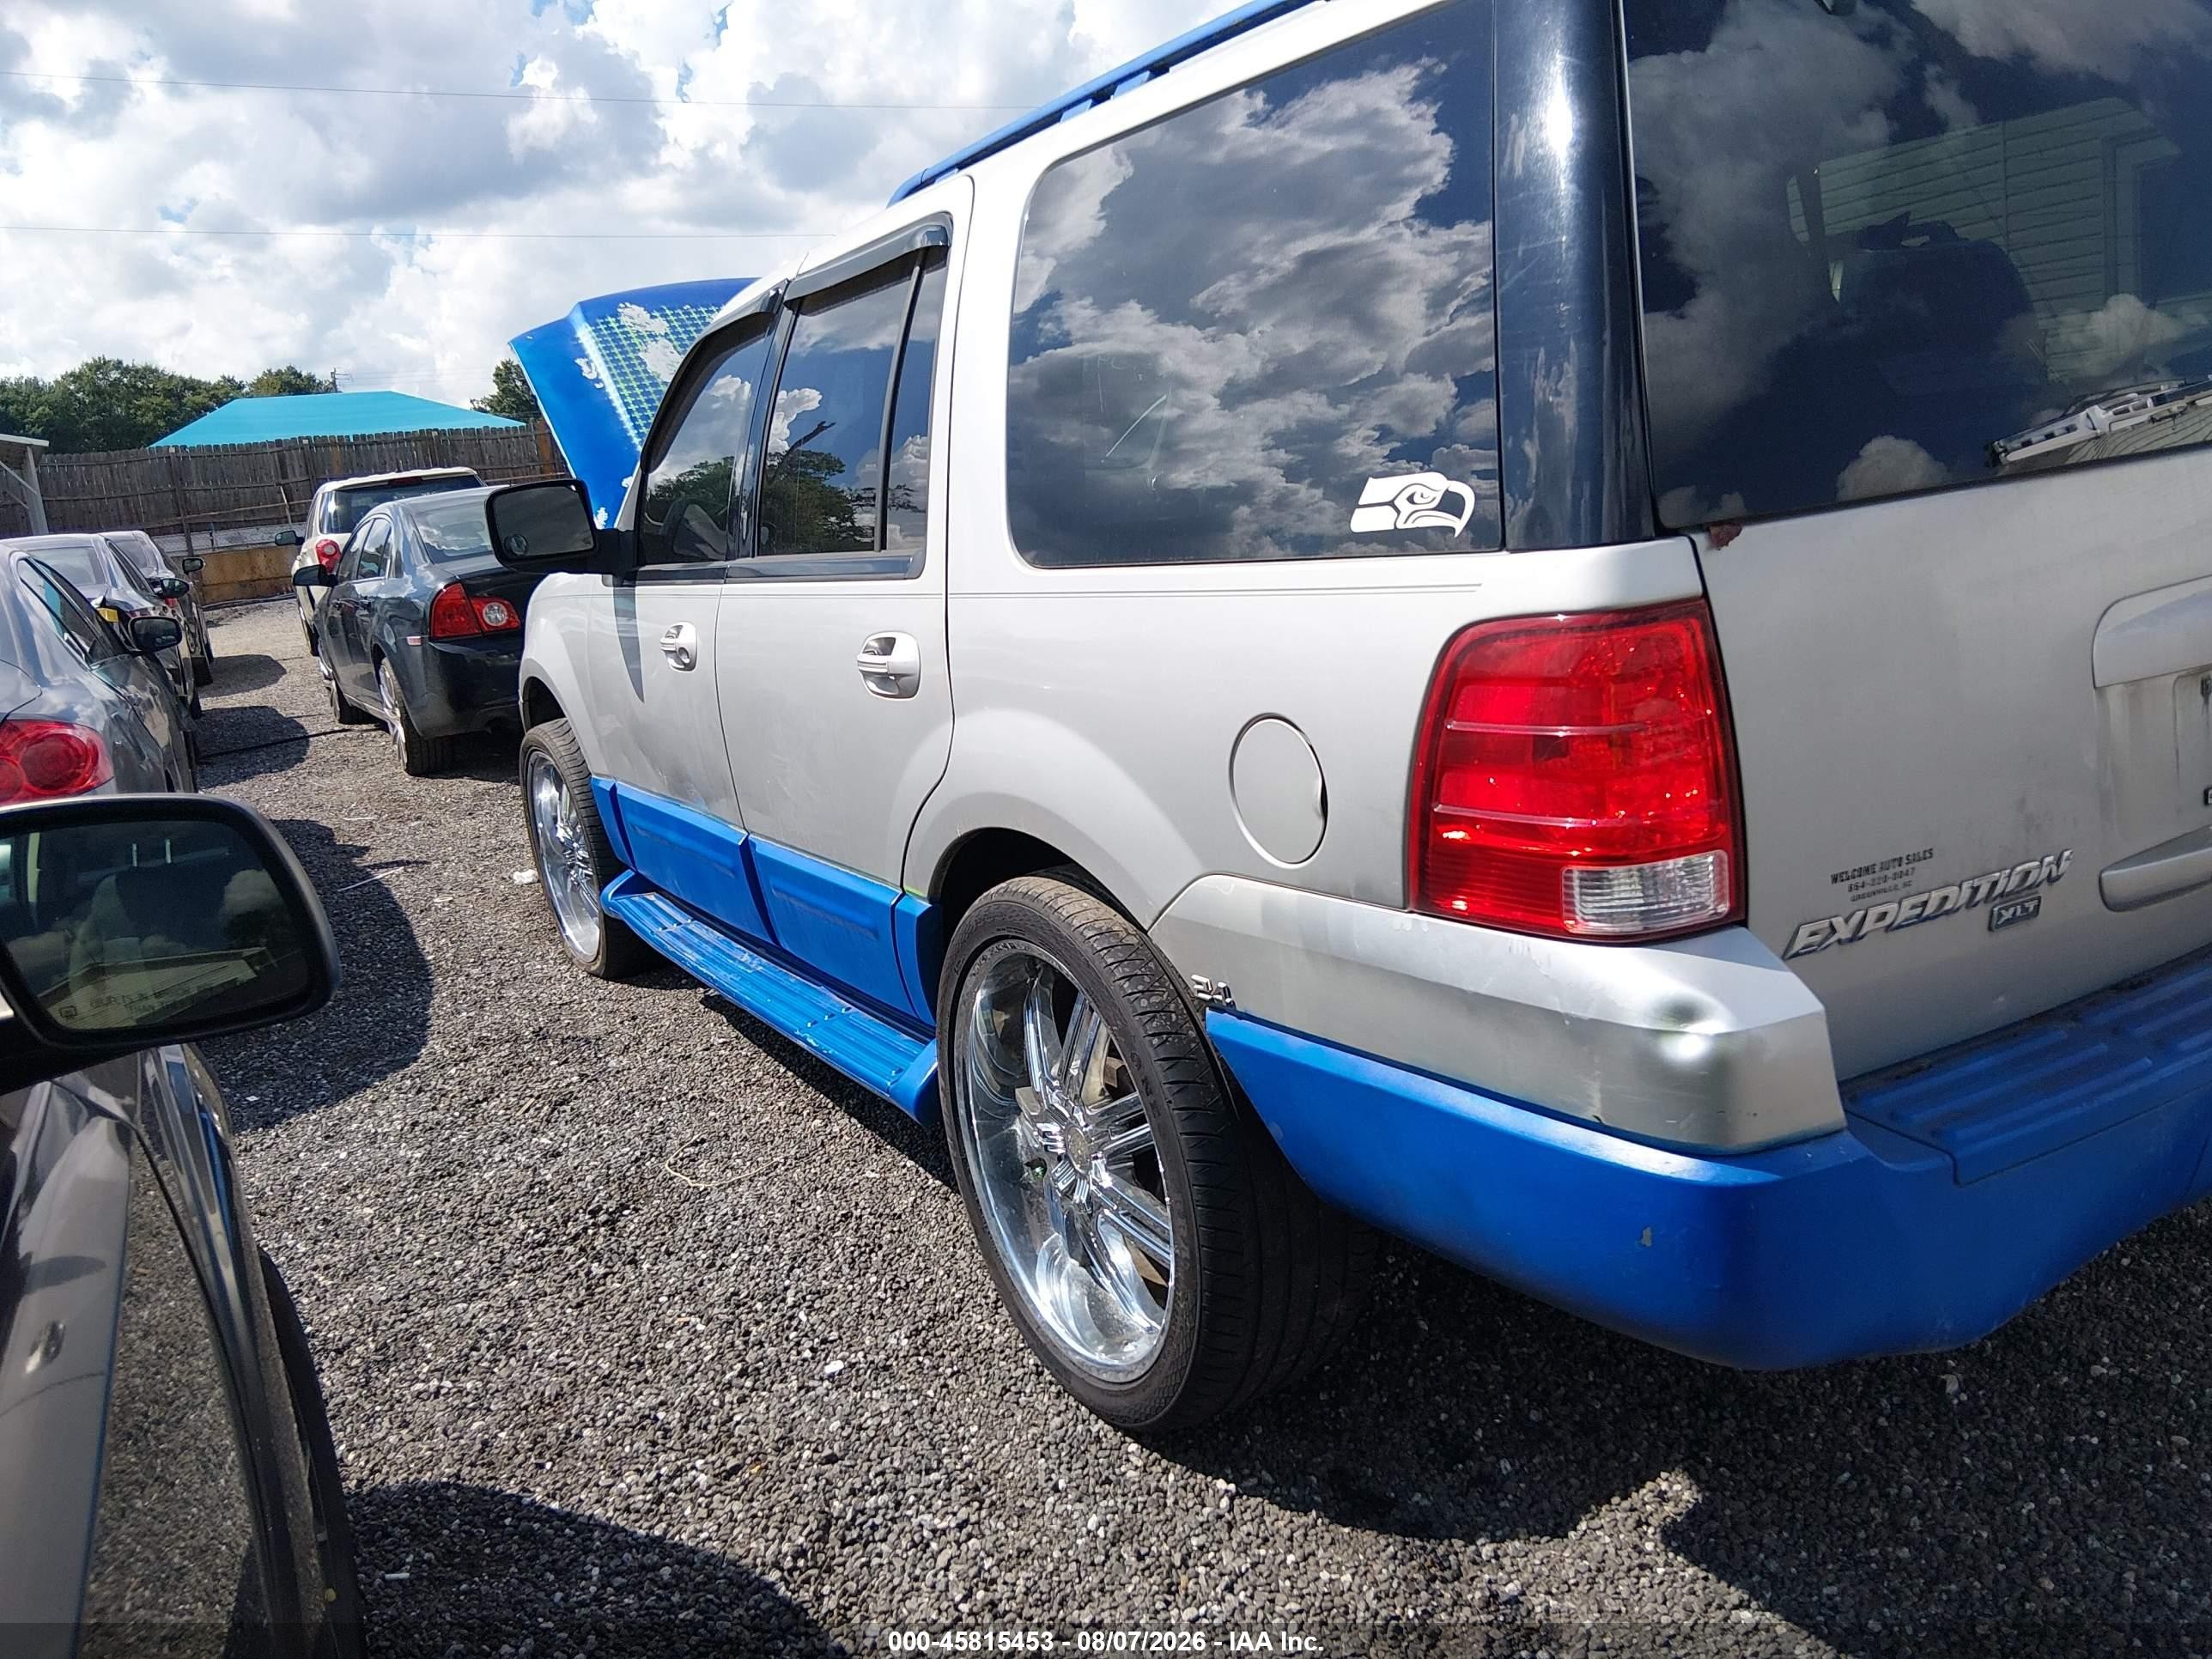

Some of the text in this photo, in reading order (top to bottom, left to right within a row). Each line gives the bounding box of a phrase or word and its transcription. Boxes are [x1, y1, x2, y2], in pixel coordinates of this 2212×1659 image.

[1830, 848, 1934, 884] WELCOME AUTO SALES
[1782, 848, 2074, 961] EXPEDITION
[1996, 901, 2039, 924] XLT
